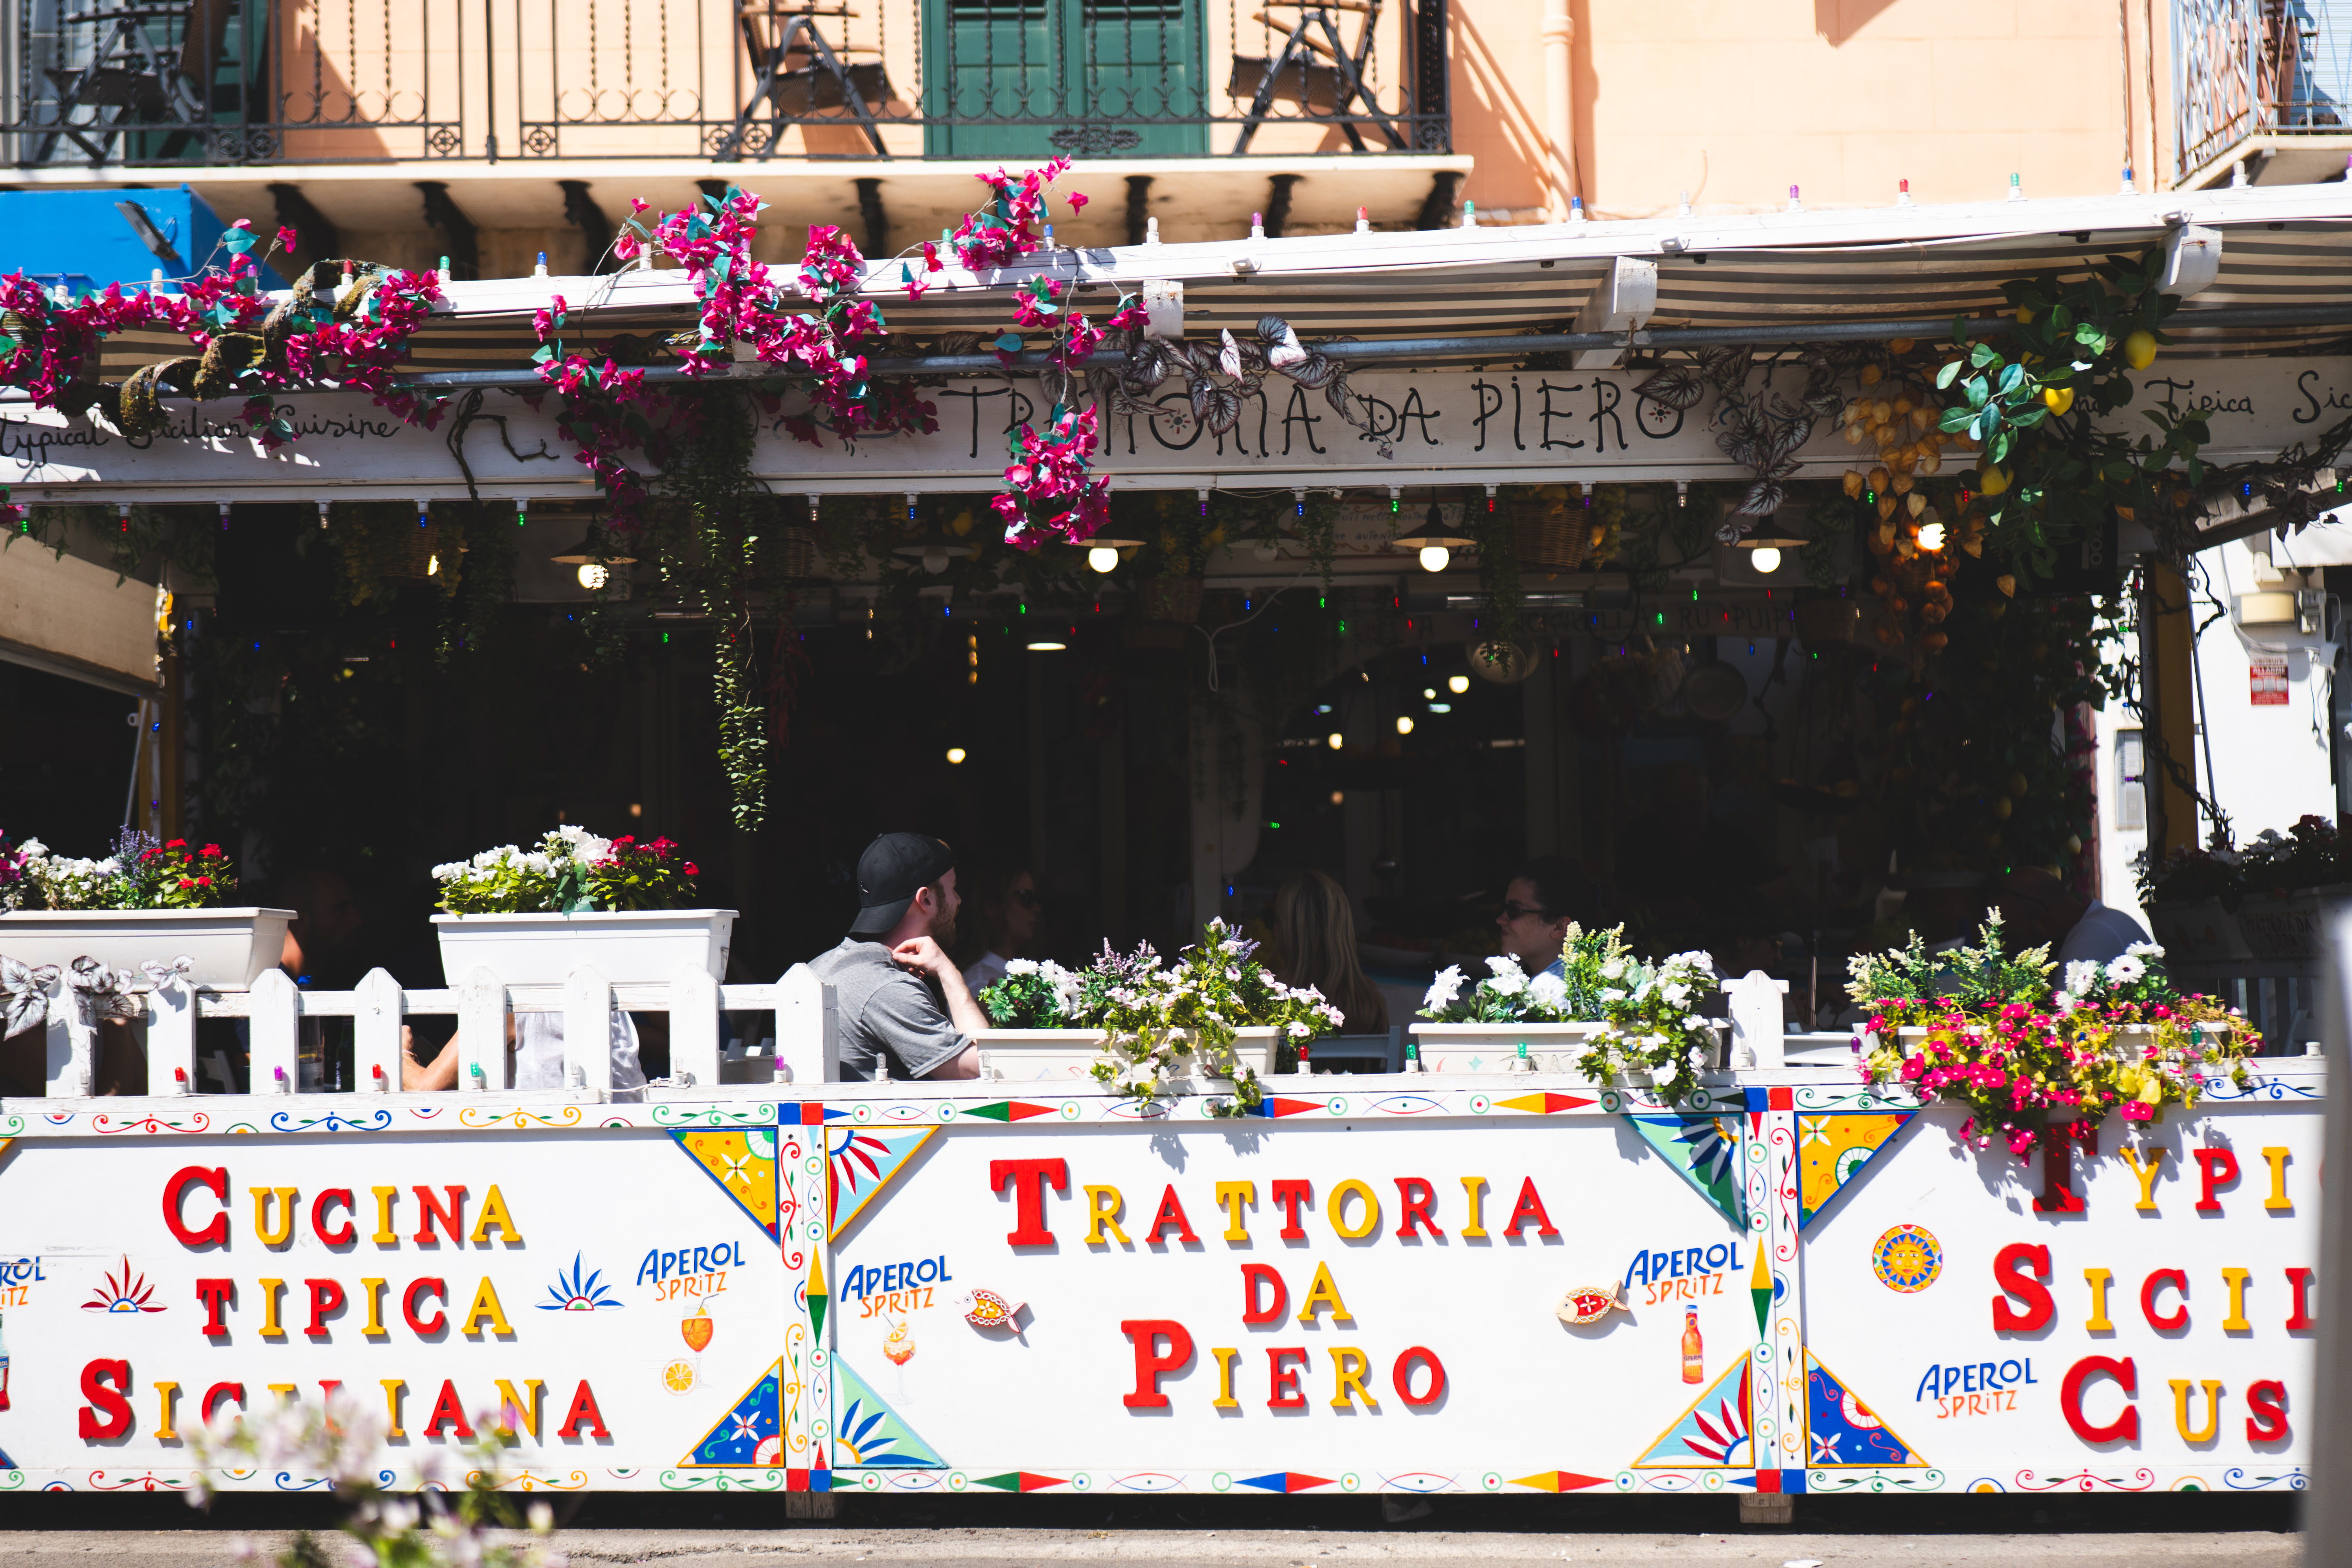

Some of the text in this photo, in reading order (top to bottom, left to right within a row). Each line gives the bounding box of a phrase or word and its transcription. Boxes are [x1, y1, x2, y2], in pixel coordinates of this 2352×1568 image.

[0, 411, 110, 469] Typical
[1358, 387, 1440, 445] DA
[1471, 375, 1684, 453] PIERO
[2253, 665, 2286, 674] ALLARME
[2032, 1122, 2324, 1211] TYPI
[162, 1166, 522, 1245] CUCINA
[990, 1158, 1559, 1245] TRATTORIA
[637, 1241, 745, 1285] APEROL
[841, 1255, 952, 1302] APEROL
[1241, 1261, 1352, 1323] DA
[1625, 1242, 1743, 1289] APEROL
[0, 1286, 28, 1309] iTZ
[196, 1277, 513, 1336] TIPICA
[1121, 1319, 1445, 1407] PIERO
[1916, 1358, 2037, 1401] APEROL
[2061, 1355, 2288, 1443] CUS
